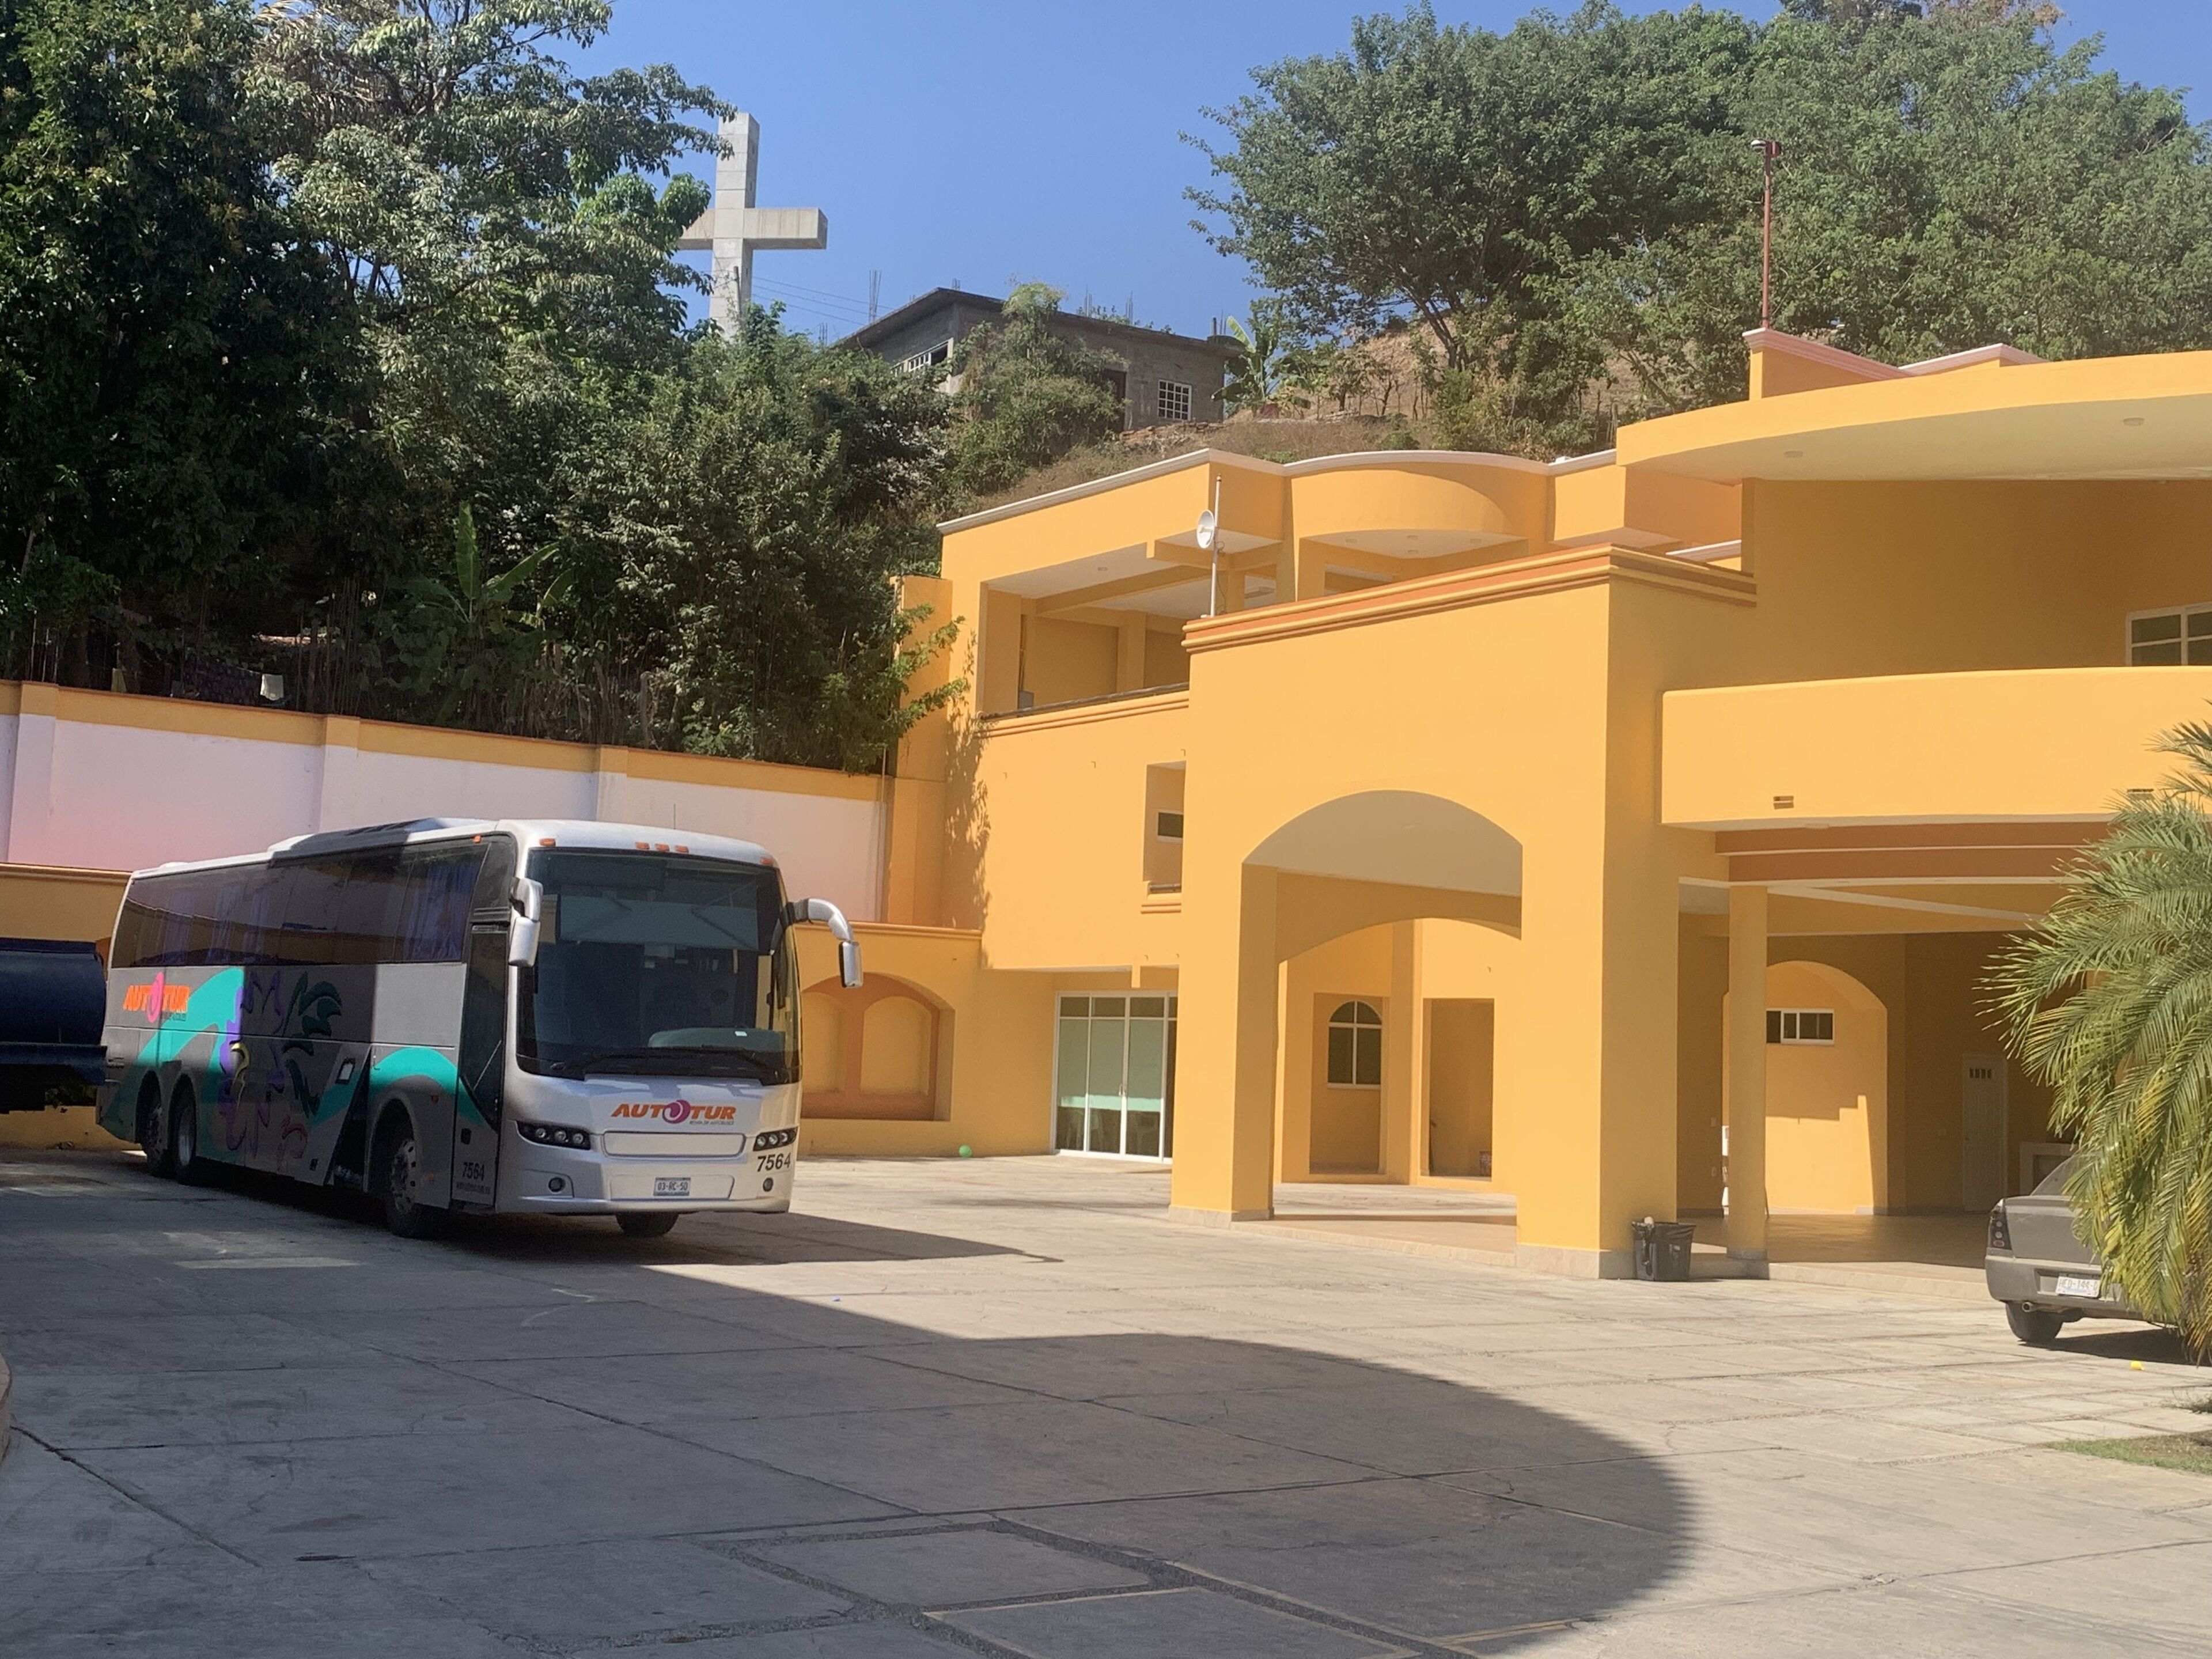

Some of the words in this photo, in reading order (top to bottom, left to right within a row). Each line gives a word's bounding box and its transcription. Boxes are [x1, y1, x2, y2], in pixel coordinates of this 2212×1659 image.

[611, 1099, 736, 1124] AUTOTUR
[462, 1161, 485, 1181] 7564
[757, 1152, 791, 1172] 7564
